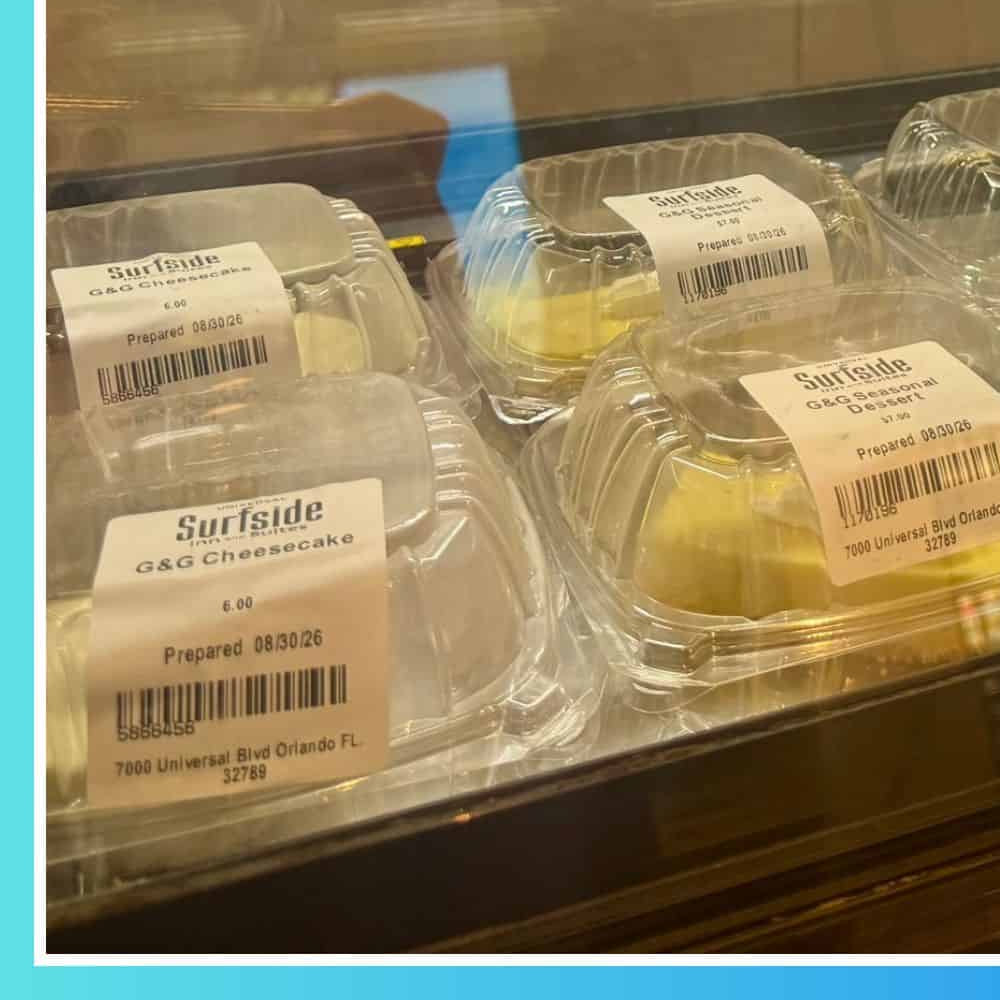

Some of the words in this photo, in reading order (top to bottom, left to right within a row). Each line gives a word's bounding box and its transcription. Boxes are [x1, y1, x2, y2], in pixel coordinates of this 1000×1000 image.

[648, 185, 743, 207] Surfside
[697, 236, 743, 252] Prepared
[89, 284, 133, 297] G&G
[138, 266, 252, 289] Cheesecake
[107, 254, 221, 280] Surfside
[164, 299, 187, 310] 6.00
[127, 325, 185, 346] Prepared
[191, 313, 244, 334] 08/30/26
[793, 356, 913, 391] Surfside
[806, 394, 851, 410] G&G
[853, 376, 940, 401] Seasonal
[847, 391, 928, 415] Dessert
[856, 435, 916, 461] Prepared
[921, 418, 973, 443] 08/30/26
[175, 498, 324, 543] Surfside
[844, 538, 872, 560] 7000
[874, 525, 929, 550] Universal
[931, 513, 957, 535] Blvd
[135, 555, 195, 575] G&G
[202, 531, 355, 567] Cheesecake
[924, 532, 957, 553] 32789
[222, 596, 253, 613] 6.00
[163, 638, 243, 665] Prepared
[254, 628, 324, 655] 08/30/26
[115, 759, 152, 778] 7000
[157, 750, 231, 774] Universal
[237, 744, 271, 763] Blvd
[275, 735, 336, 759] Orlando
[223, 763, 268, 785] 32789
